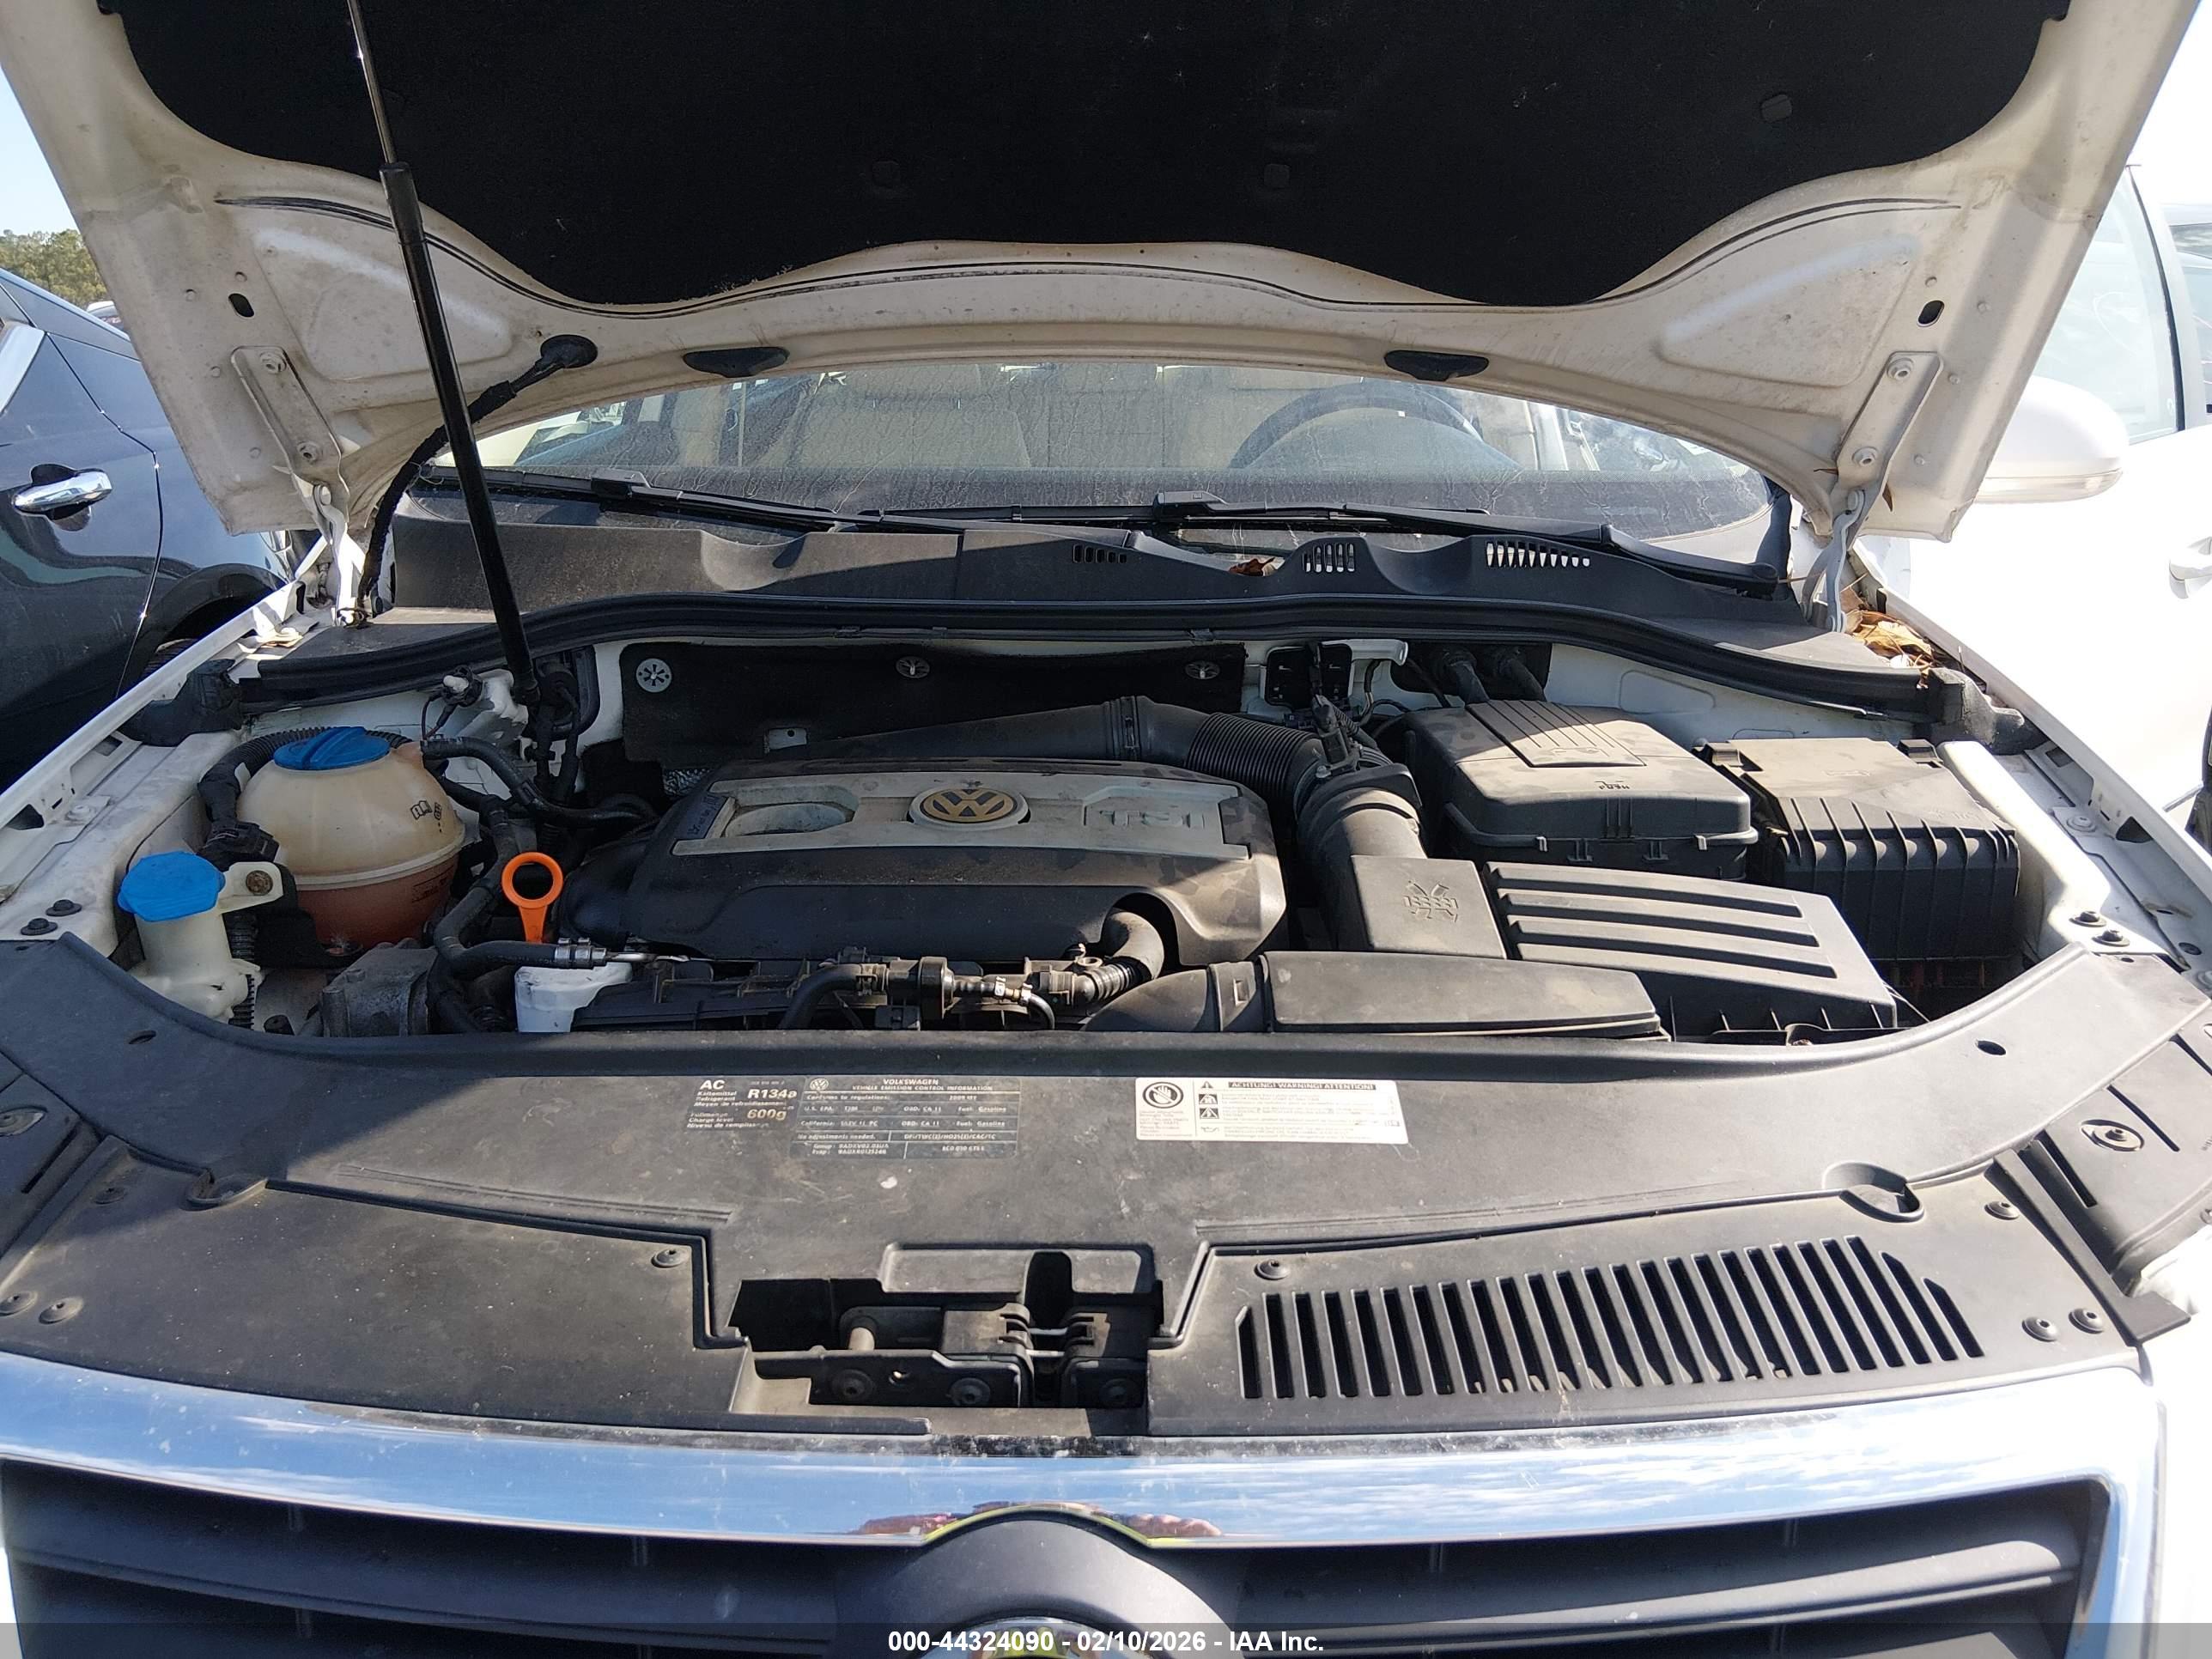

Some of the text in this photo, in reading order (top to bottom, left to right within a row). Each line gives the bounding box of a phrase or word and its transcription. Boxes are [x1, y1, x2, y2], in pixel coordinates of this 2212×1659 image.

[700, 1079, 726, 1091] AC
[747, 1088, 798, 1100] R134a
[746, 1109, 787, 1121] 600g
